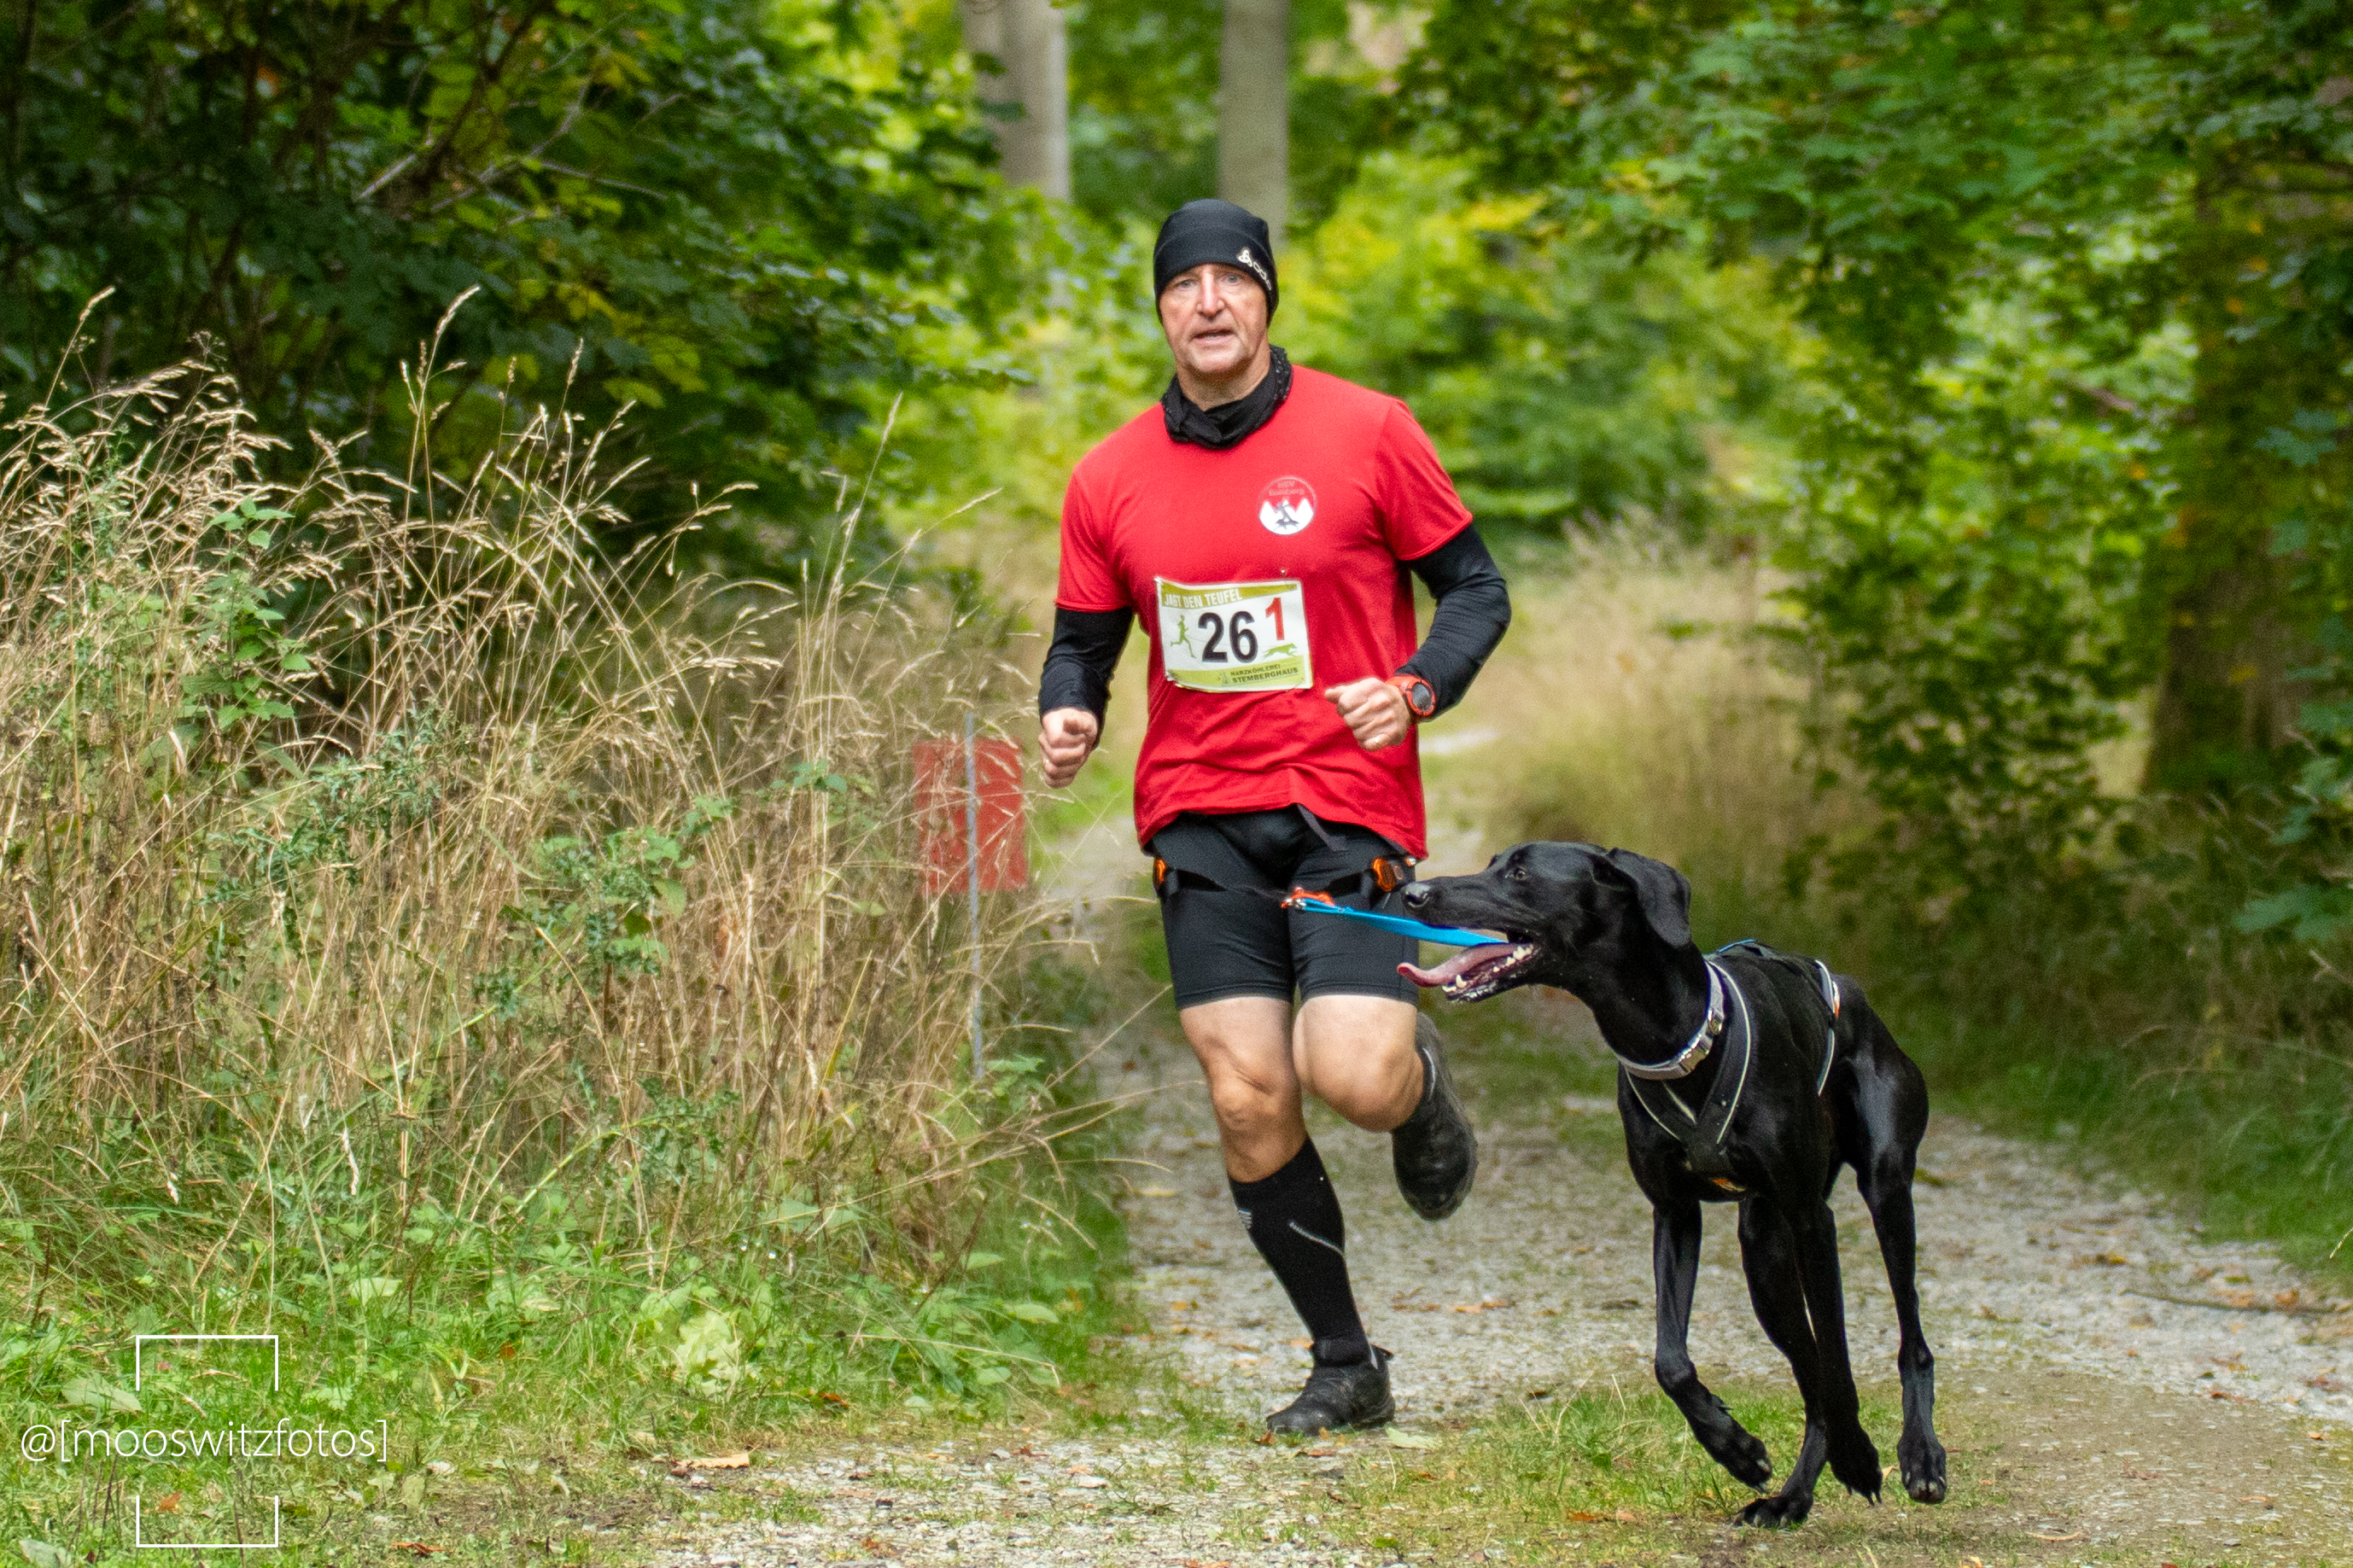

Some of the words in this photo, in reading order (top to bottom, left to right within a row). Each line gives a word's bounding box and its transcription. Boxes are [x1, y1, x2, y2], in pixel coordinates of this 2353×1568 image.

[1164, 593, 1182, 607] JAGT
[1183, 593, 1203, 608] DEN
[1204, 588, 1243, 607] TEUFEL
[1232, 667, 1299, 684] STEMBERGHAUS
